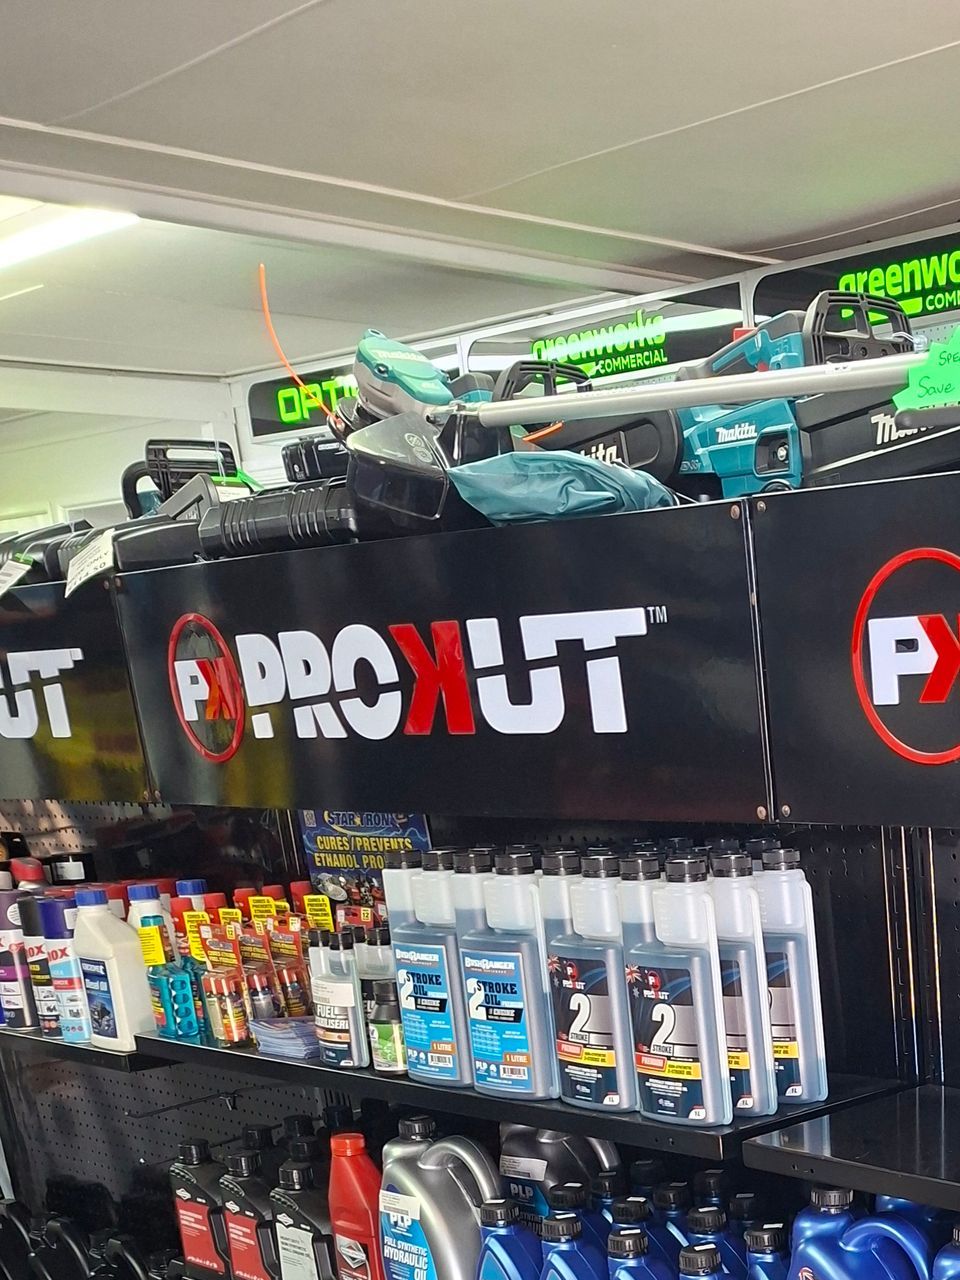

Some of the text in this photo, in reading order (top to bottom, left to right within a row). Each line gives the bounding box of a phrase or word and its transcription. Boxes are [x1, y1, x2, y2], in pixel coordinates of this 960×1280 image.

[597, 349, 668, 375] COMMERCIAL
[918, 376, 955, 398] Save
[716, 422, 758, 443] Makita
[235, 606, 648, 741] PROKUT
[314, 853, 360, 869] ETHANOL
[397, 969, 442, 1010] 2 STROKE
[413, 984, 428, 997] OIL
[466, 978, 517, 1021] 2 STROKE
[484, 993, 500, 1006] OIL
[317, 1004, 337, 1018] FUEL
[569, 993, 591, 1042] 2 STROKE
[651, 1003, 675, 1054] 2 STROKE
[510, 1183, 534, 1198] PLP
[384, 1236, 427, 1257] FULL SYNTHETIC
[384, 1245, 428, 1270] HYDRAULIC
